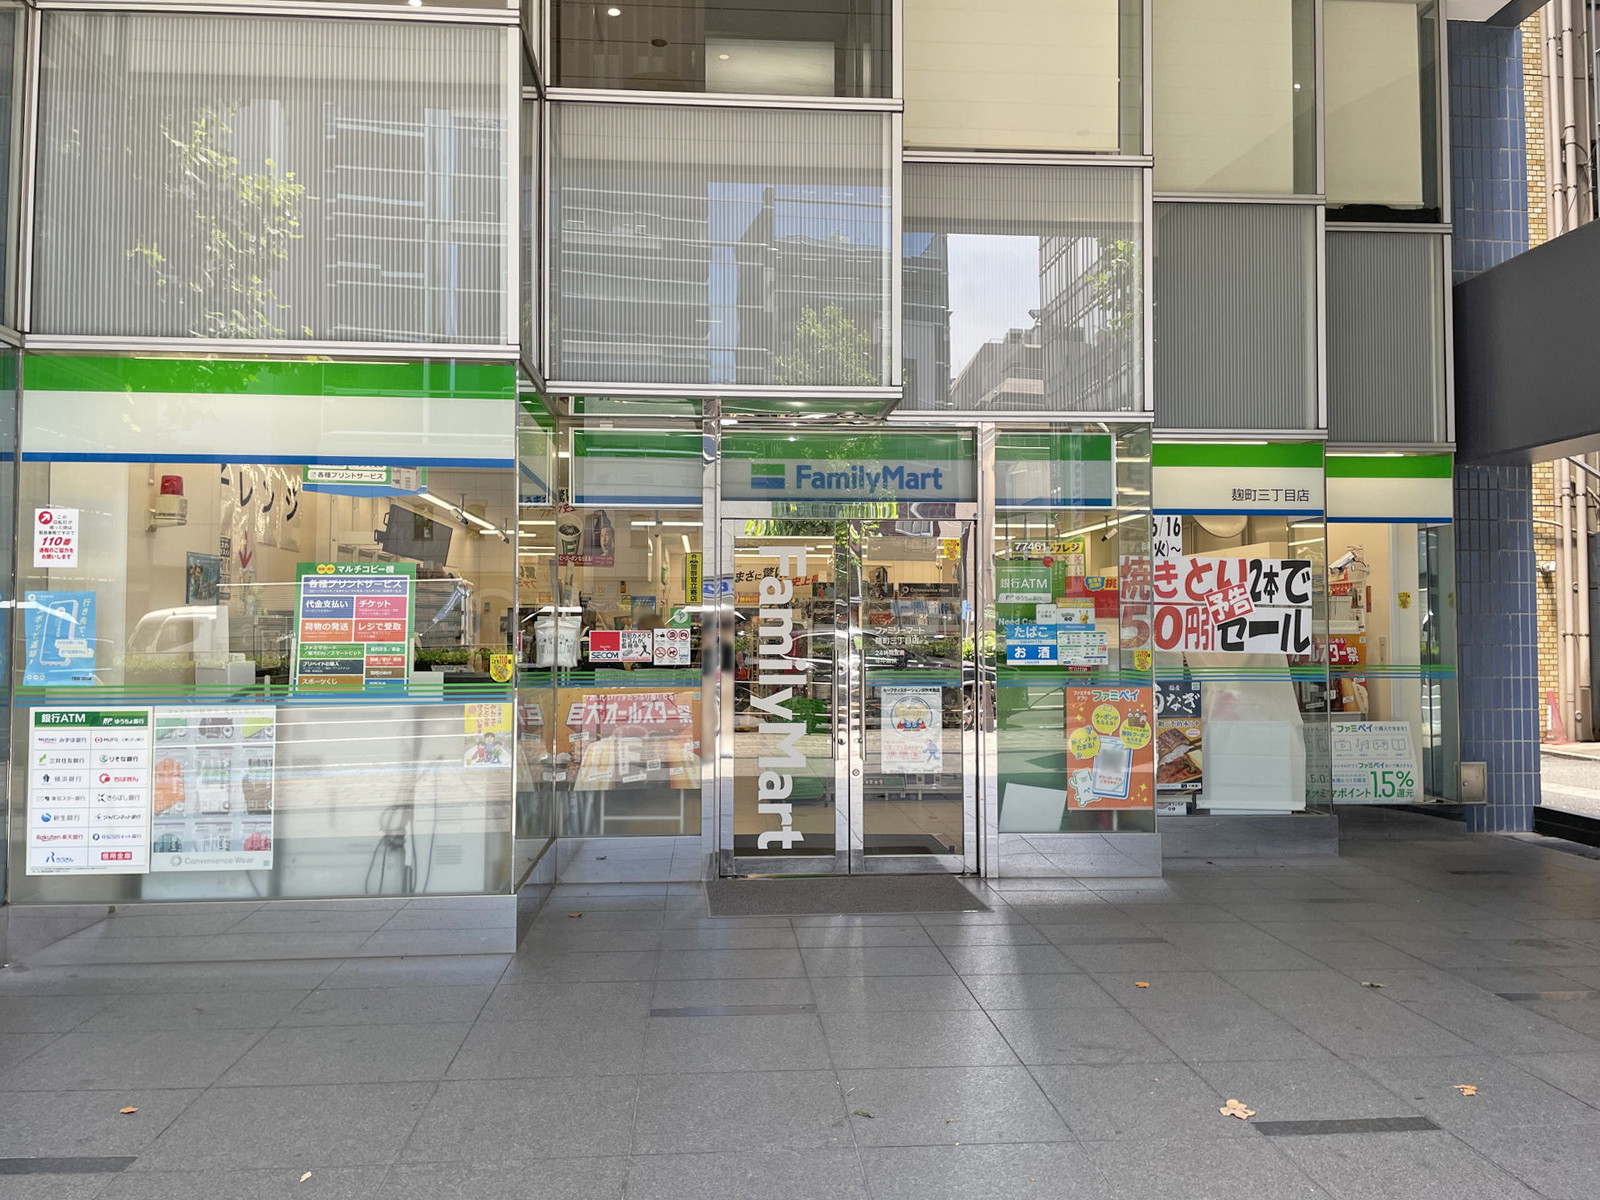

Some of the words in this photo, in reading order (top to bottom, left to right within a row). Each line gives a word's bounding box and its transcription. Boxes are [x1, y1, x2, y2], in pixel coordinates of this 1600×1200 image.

[317, 471, 385, 482] 各種プリントサービス
[796, 464, 943, 494] FamilyMart
[1231, 488, 1310, 502] 麹町三丁目店
[42, 536, 72, 546] 110番
[1014, 542, 1047, 552] 77461
[337, 565, 395, 574] マルチコピー機
[308, 579, 402, 589] 各種プリントサービス
[1001, 578, 1048, 588] 銀行ATM
[1248, 558, 1311, 605] 2本で
[306, 599, 349, 608] 代金支払い
[359, 600, 391, 608] チケット
[1208, 585, 1252, 623] 予告
[304, 622, 349, 631] 荷物の発送
[358, 622, 402, 631] レジで受取
[998, 618, 1021, 626] Need
[874, 626, 925, 635] ファミリーマート
[1014, 626, 1049, 638] たばこ
[1217, 608, 1311, 654] セール
[591, 651, 619, 659] SECOM
[750, 545, 807, 849] FamilyMart
[1092, 689, 1140, 702] ファミペイ
[567, 701, 693, 725] 巨大オールスター祭
[41, 713, 86, 724] 銀行ATM
[1336, 724, 1373, 733] ファミペイ
[109, 755, 139, 763] りそな銀行
[1370, 771, 1414, 798] 1.5%
[1396, 788, 1415, 798] 還元
[102, 852, 132, 860] 信用金庫
[184, 856, 234, 865] Convenience
[235, 856, 254, 864] Wear
